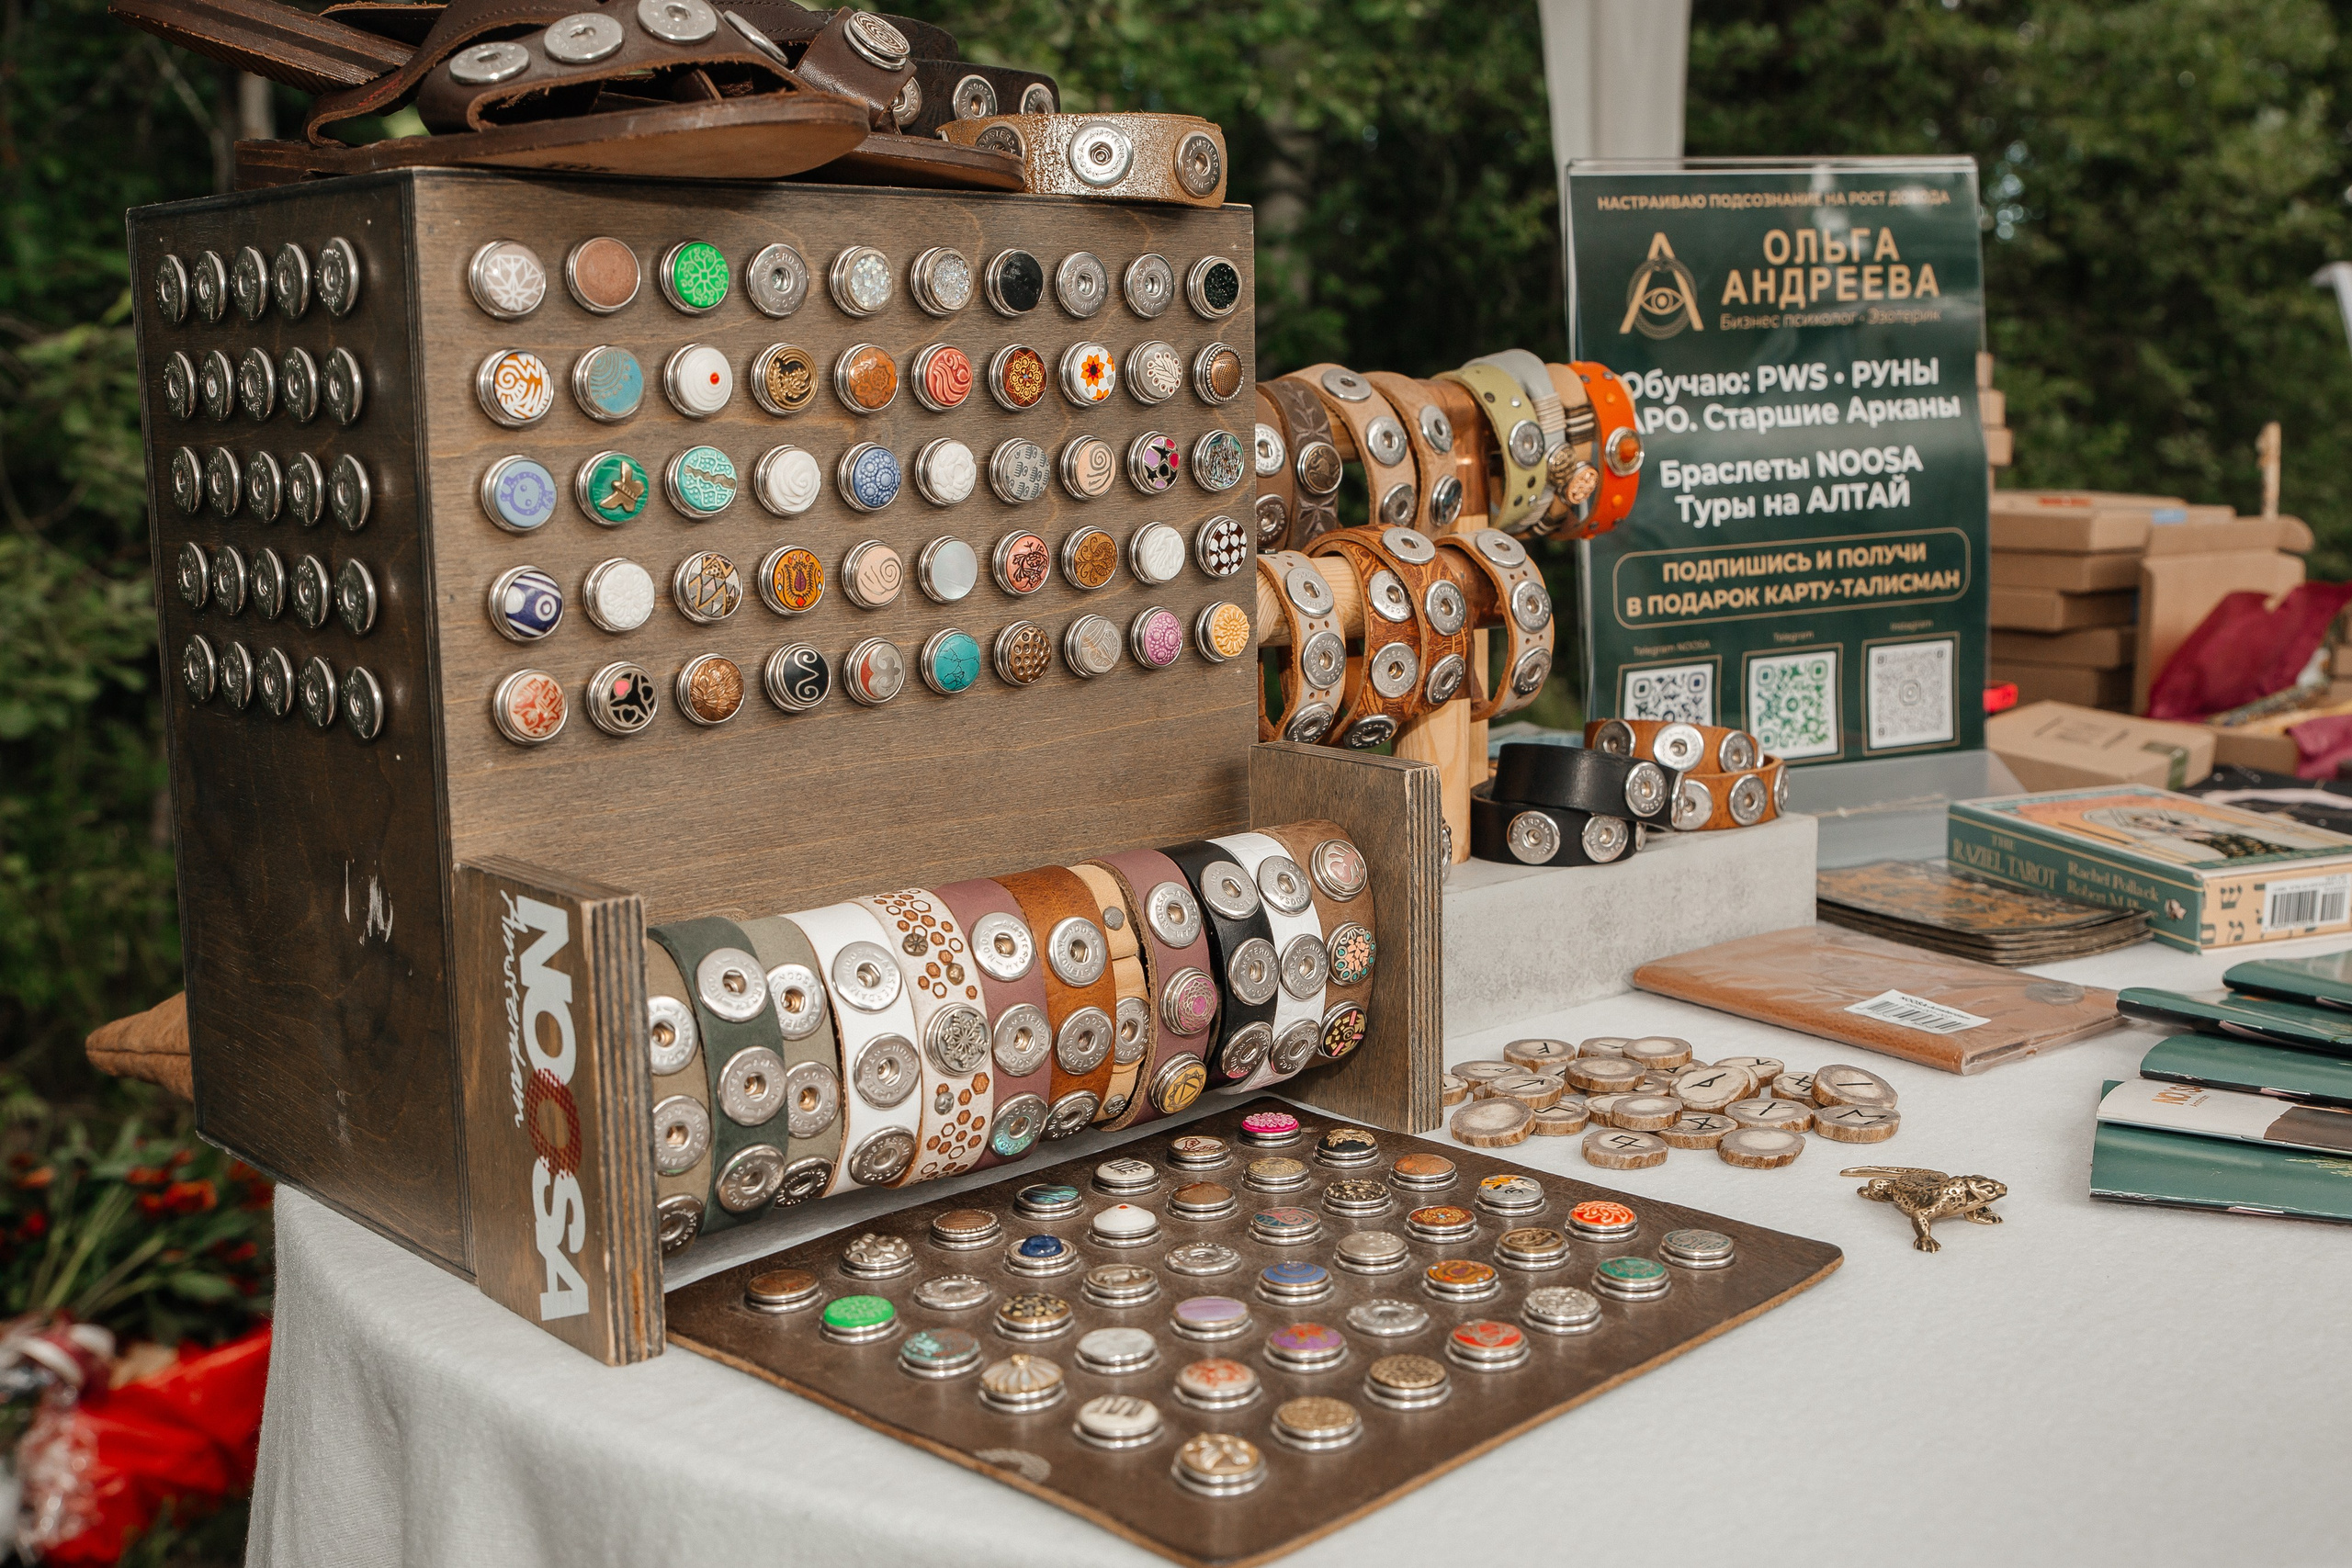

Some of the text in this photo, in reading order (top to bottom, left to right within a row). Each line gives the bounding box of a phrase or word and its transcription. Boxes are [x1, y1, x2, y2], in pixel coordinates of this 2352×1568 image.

[1597, 194, 1707, 210] НАСТРАИВАЮ
[1709, 191, 1824, 209] ПОДСОЗНАНИЕ
[1825, 191, 1847, 207] НА
[1848, 190, 1886, 207] РОСТ
[1763, 226, 1901, 266] ОЛЬГА
[760, 252, 804, 286] AMSTERDAM
[1721, 263, 1940, 310] АНДРЕЕВА
[1720, 307, 1942, 331] Бизнес психолог Эзотерик
[1622, 356, 1940, 404] Обучаю: PWS РУНЫ
[1702, 402, 1838, 434] Старшие
[1846, 395, 1962, 428] Арканы
[1659, 445, 1924, 491] Браслеты NOOSA
[1674, 475, 1911, 528] Туры на АЛТАЙ
[1662, 542, 1928, 584] ПОДПИШИСЬ И ПОЛУЧИ
[1625, 570, 1961, 618] В ПОДАРОК КАРТУ-ТАЛИСМАН
[1952, 837, 2058, 891] RAZIEL TAROT
[1068, 924, 1099, 946] NOOSA
[1240, 946, 1277, 976] AMSTERDAM
[500, 889, 528, 1128] Amsterdam
[1007, 1013, 1047, 1053] AMSTERDAM
[515, 894, 590, 1321] NOOSA
